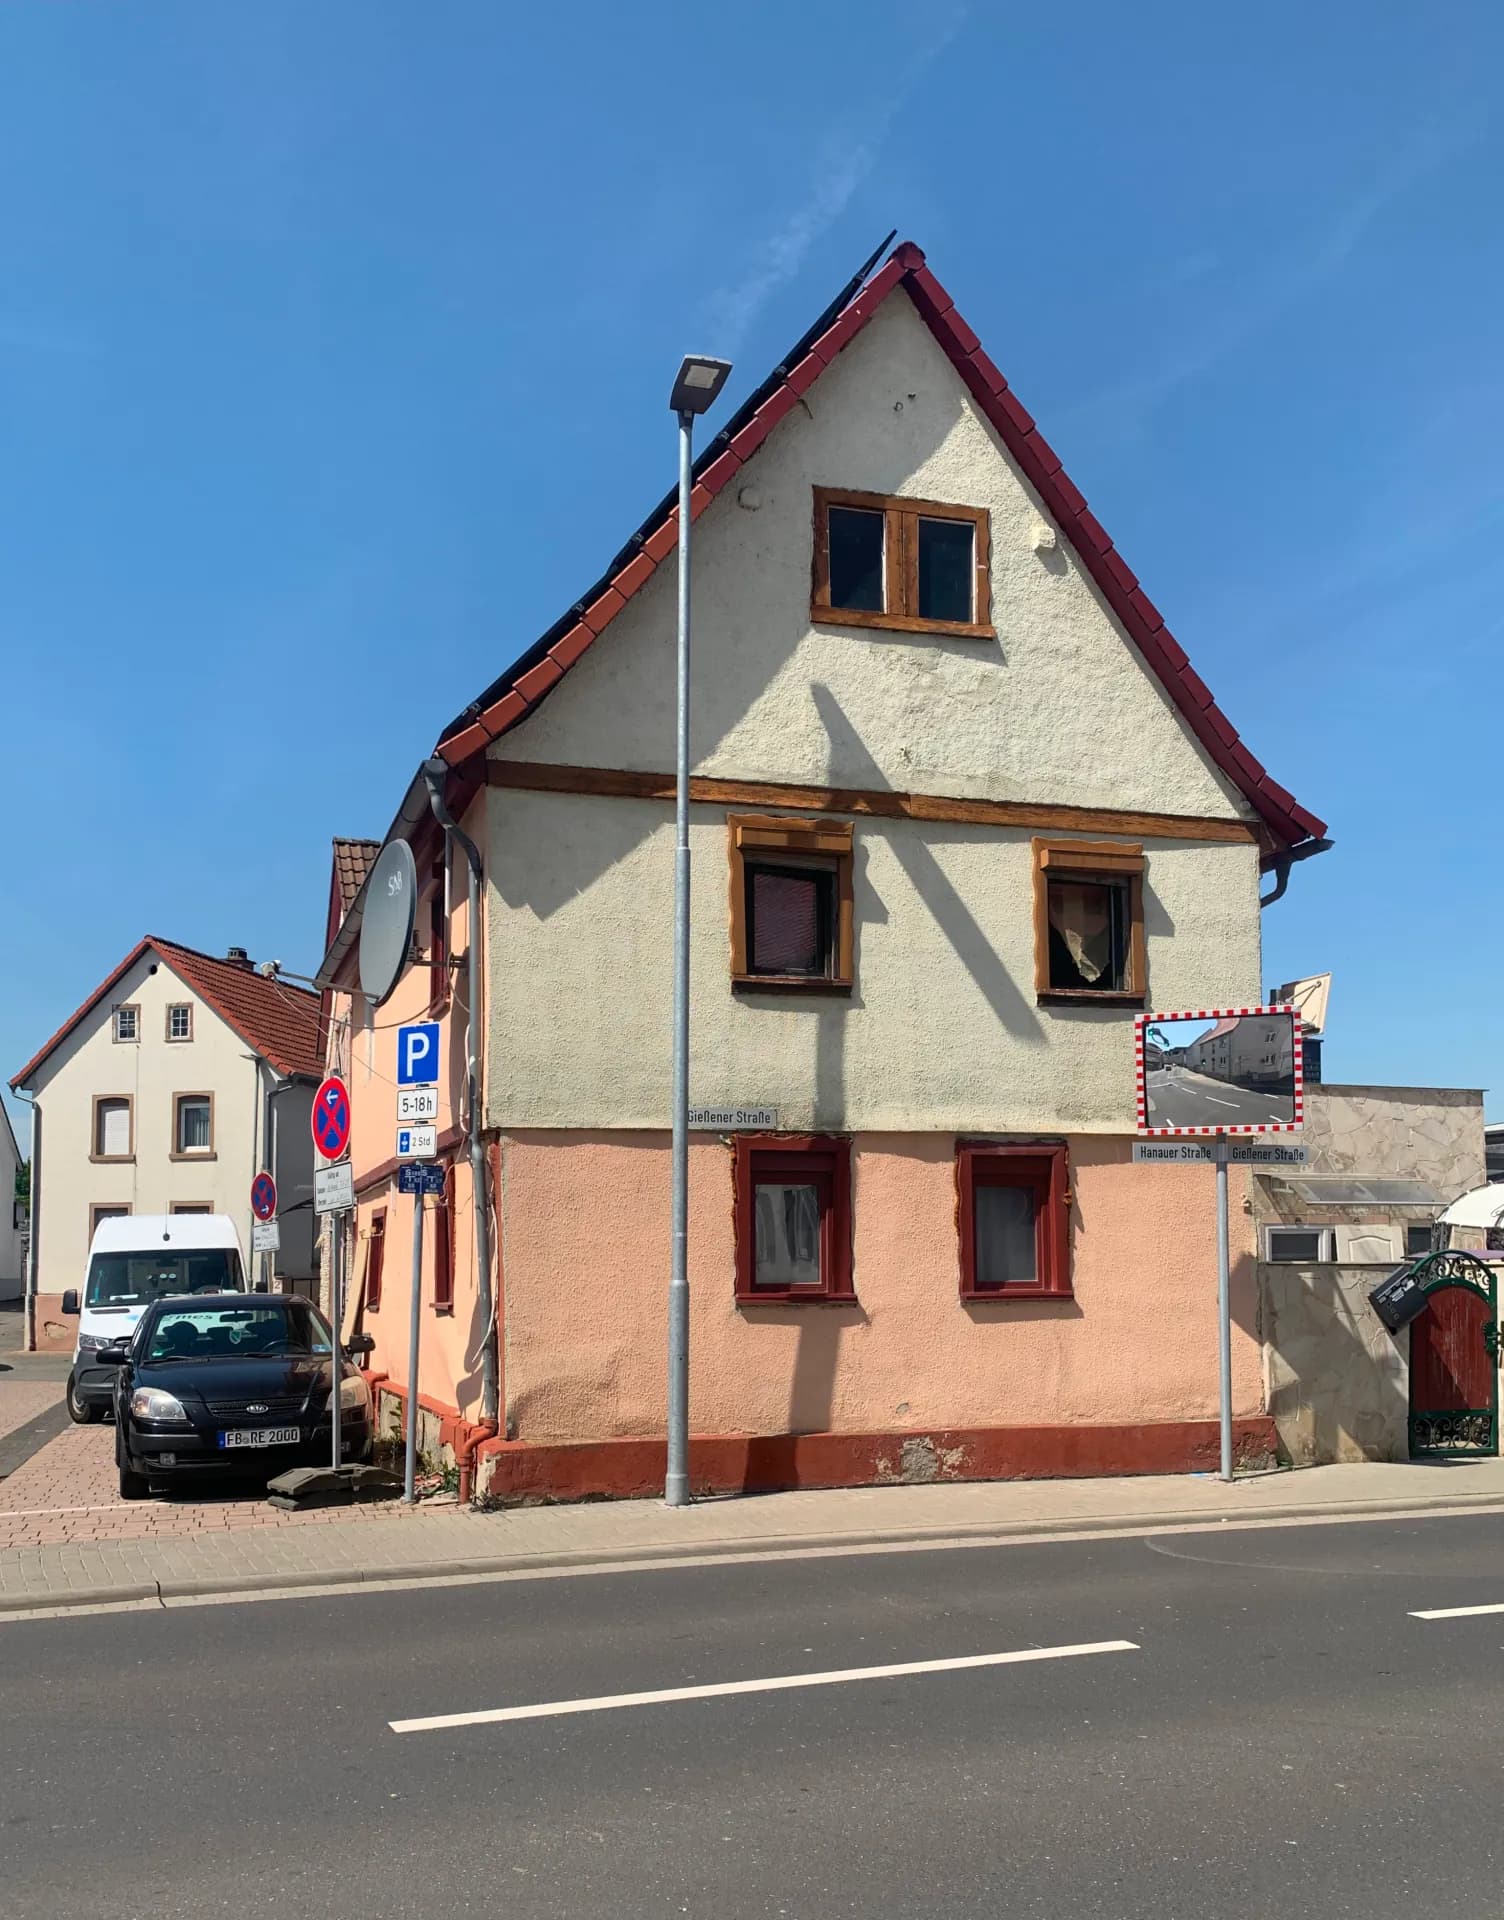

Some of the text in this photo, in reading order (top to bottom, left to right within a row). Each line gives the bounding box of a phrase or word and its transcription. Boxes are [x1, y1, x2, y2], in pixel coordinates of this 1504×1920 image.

[407, 1032, 430, 1077] P
[687, 1110, 771, 1124] Gießener Straße
[412, 1137, 417, 1147] 2
[1140, 1145, 1212, 1159] Hanauer Straße
[1232, 1147, 1305, 1161] Gießener Straße
[227, 1428, 298, 1446] FB RE 2000
